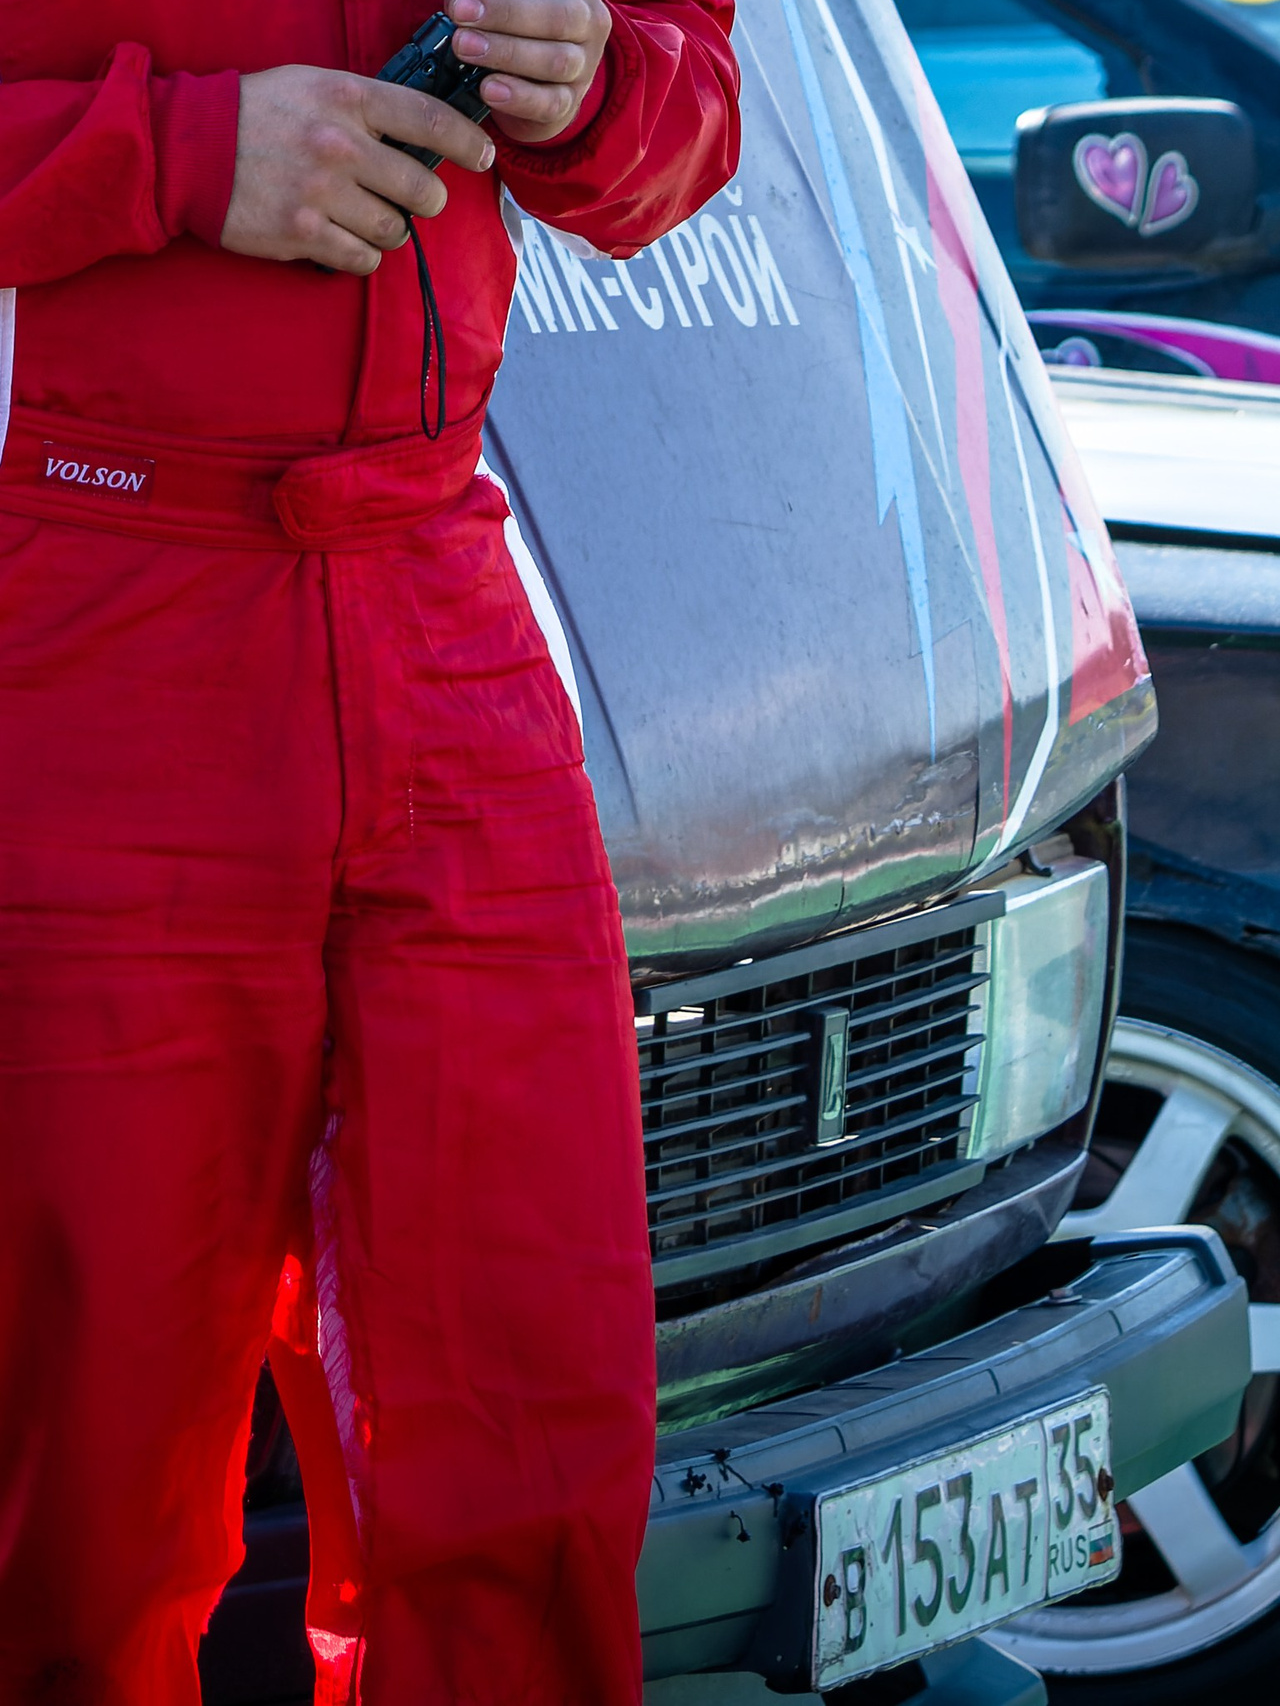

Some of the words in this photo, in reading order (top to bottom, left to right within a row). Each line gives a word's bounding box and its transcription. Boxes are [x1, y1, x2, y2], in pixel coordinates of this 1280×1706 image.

[44, 457, 147, 493] VOLSON
[1051, 1413, 1098, 1530] 35
[1048, 1534, 1088, 1579] RUS
